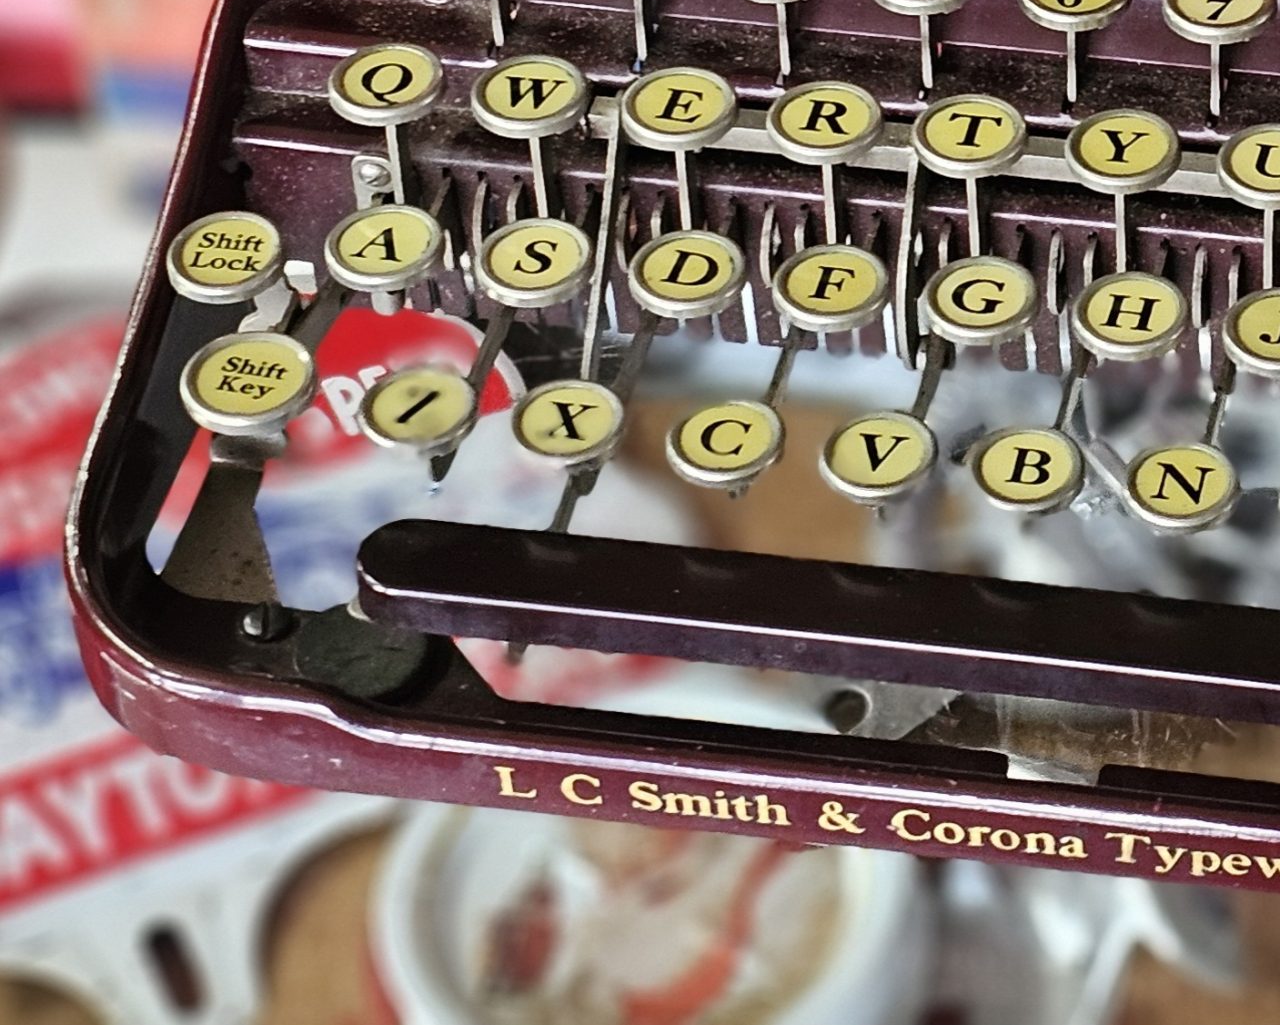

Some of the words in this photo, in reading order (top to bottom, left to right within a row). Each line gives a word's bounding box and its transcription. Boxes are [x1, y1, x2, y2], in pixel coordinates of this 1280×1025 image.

[361, 63, 413, 104] Q
[505, 75, 567, 110] W
[655, 87, 703, 124] E
[798, 99, 849, 135] R
[948, 112, 1003, 148] T
[1100, 129, 1150, 164] Y
[197, 231, 265, 253] Shift
[349, 227, 402, 263] A
[513, 240, 558, 275] S
[188, 251, 262, 272] Lock
[660, 249, 719, 286] D
[807, 265, 856, 300] F
[951, 278, 1006, 315] G
[1099, 293, 1161, 332] H
[221, 356, 289, 381] Shift
[215, 374, 275, 401] Key
[548, 401, 599, 441] X
[700, 419, 752, 456] C
[859, 432, 911, 472] V
[1004, 447, 1052, 485] B
[1149, 461, 1216, 505] N
[493, 766, 538, 800] L
[560, 773, 604, 806] C
[628, 781, 793, 826] Smith
[817, 799, 867, 835] &
[888, 808, 1089, 860] Corona
